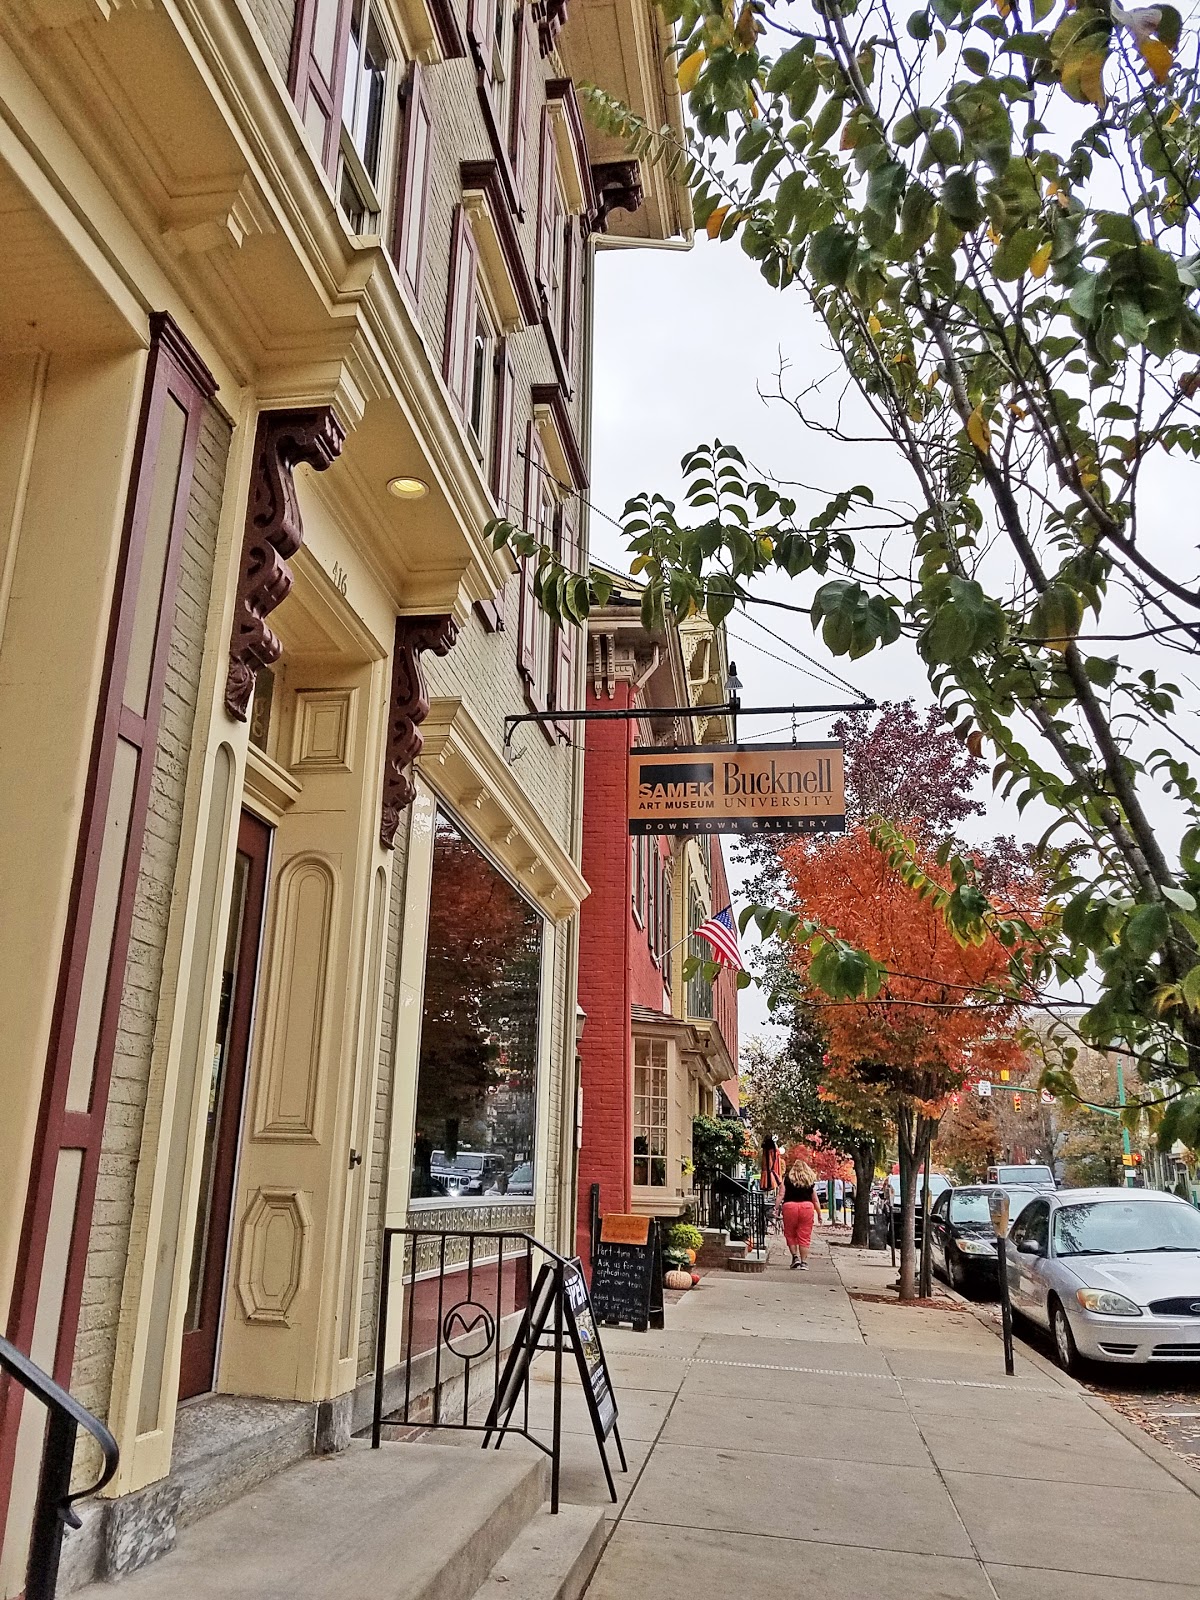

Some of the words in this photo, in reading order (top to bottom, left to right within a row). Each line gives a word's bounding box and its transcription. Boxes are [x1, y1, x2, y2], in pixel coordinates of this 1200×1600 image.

[722, 758, 834, 796] Bucknell
[639, 781, 715, 799] SAMEK
[639, 801, 660, 810] ART
[665, 800, 715, 810] MUSEUM
[724, 795, 834, 809] UNIVERSITY
[645, 822, 738, 831] DOWNTOWN
[752, 820, 828, 829] GALLERY
[597, 1259, 610, 1268] Ask
[623, 1260, 634, 1270] for
[597, 1268, 630, 1278] application
